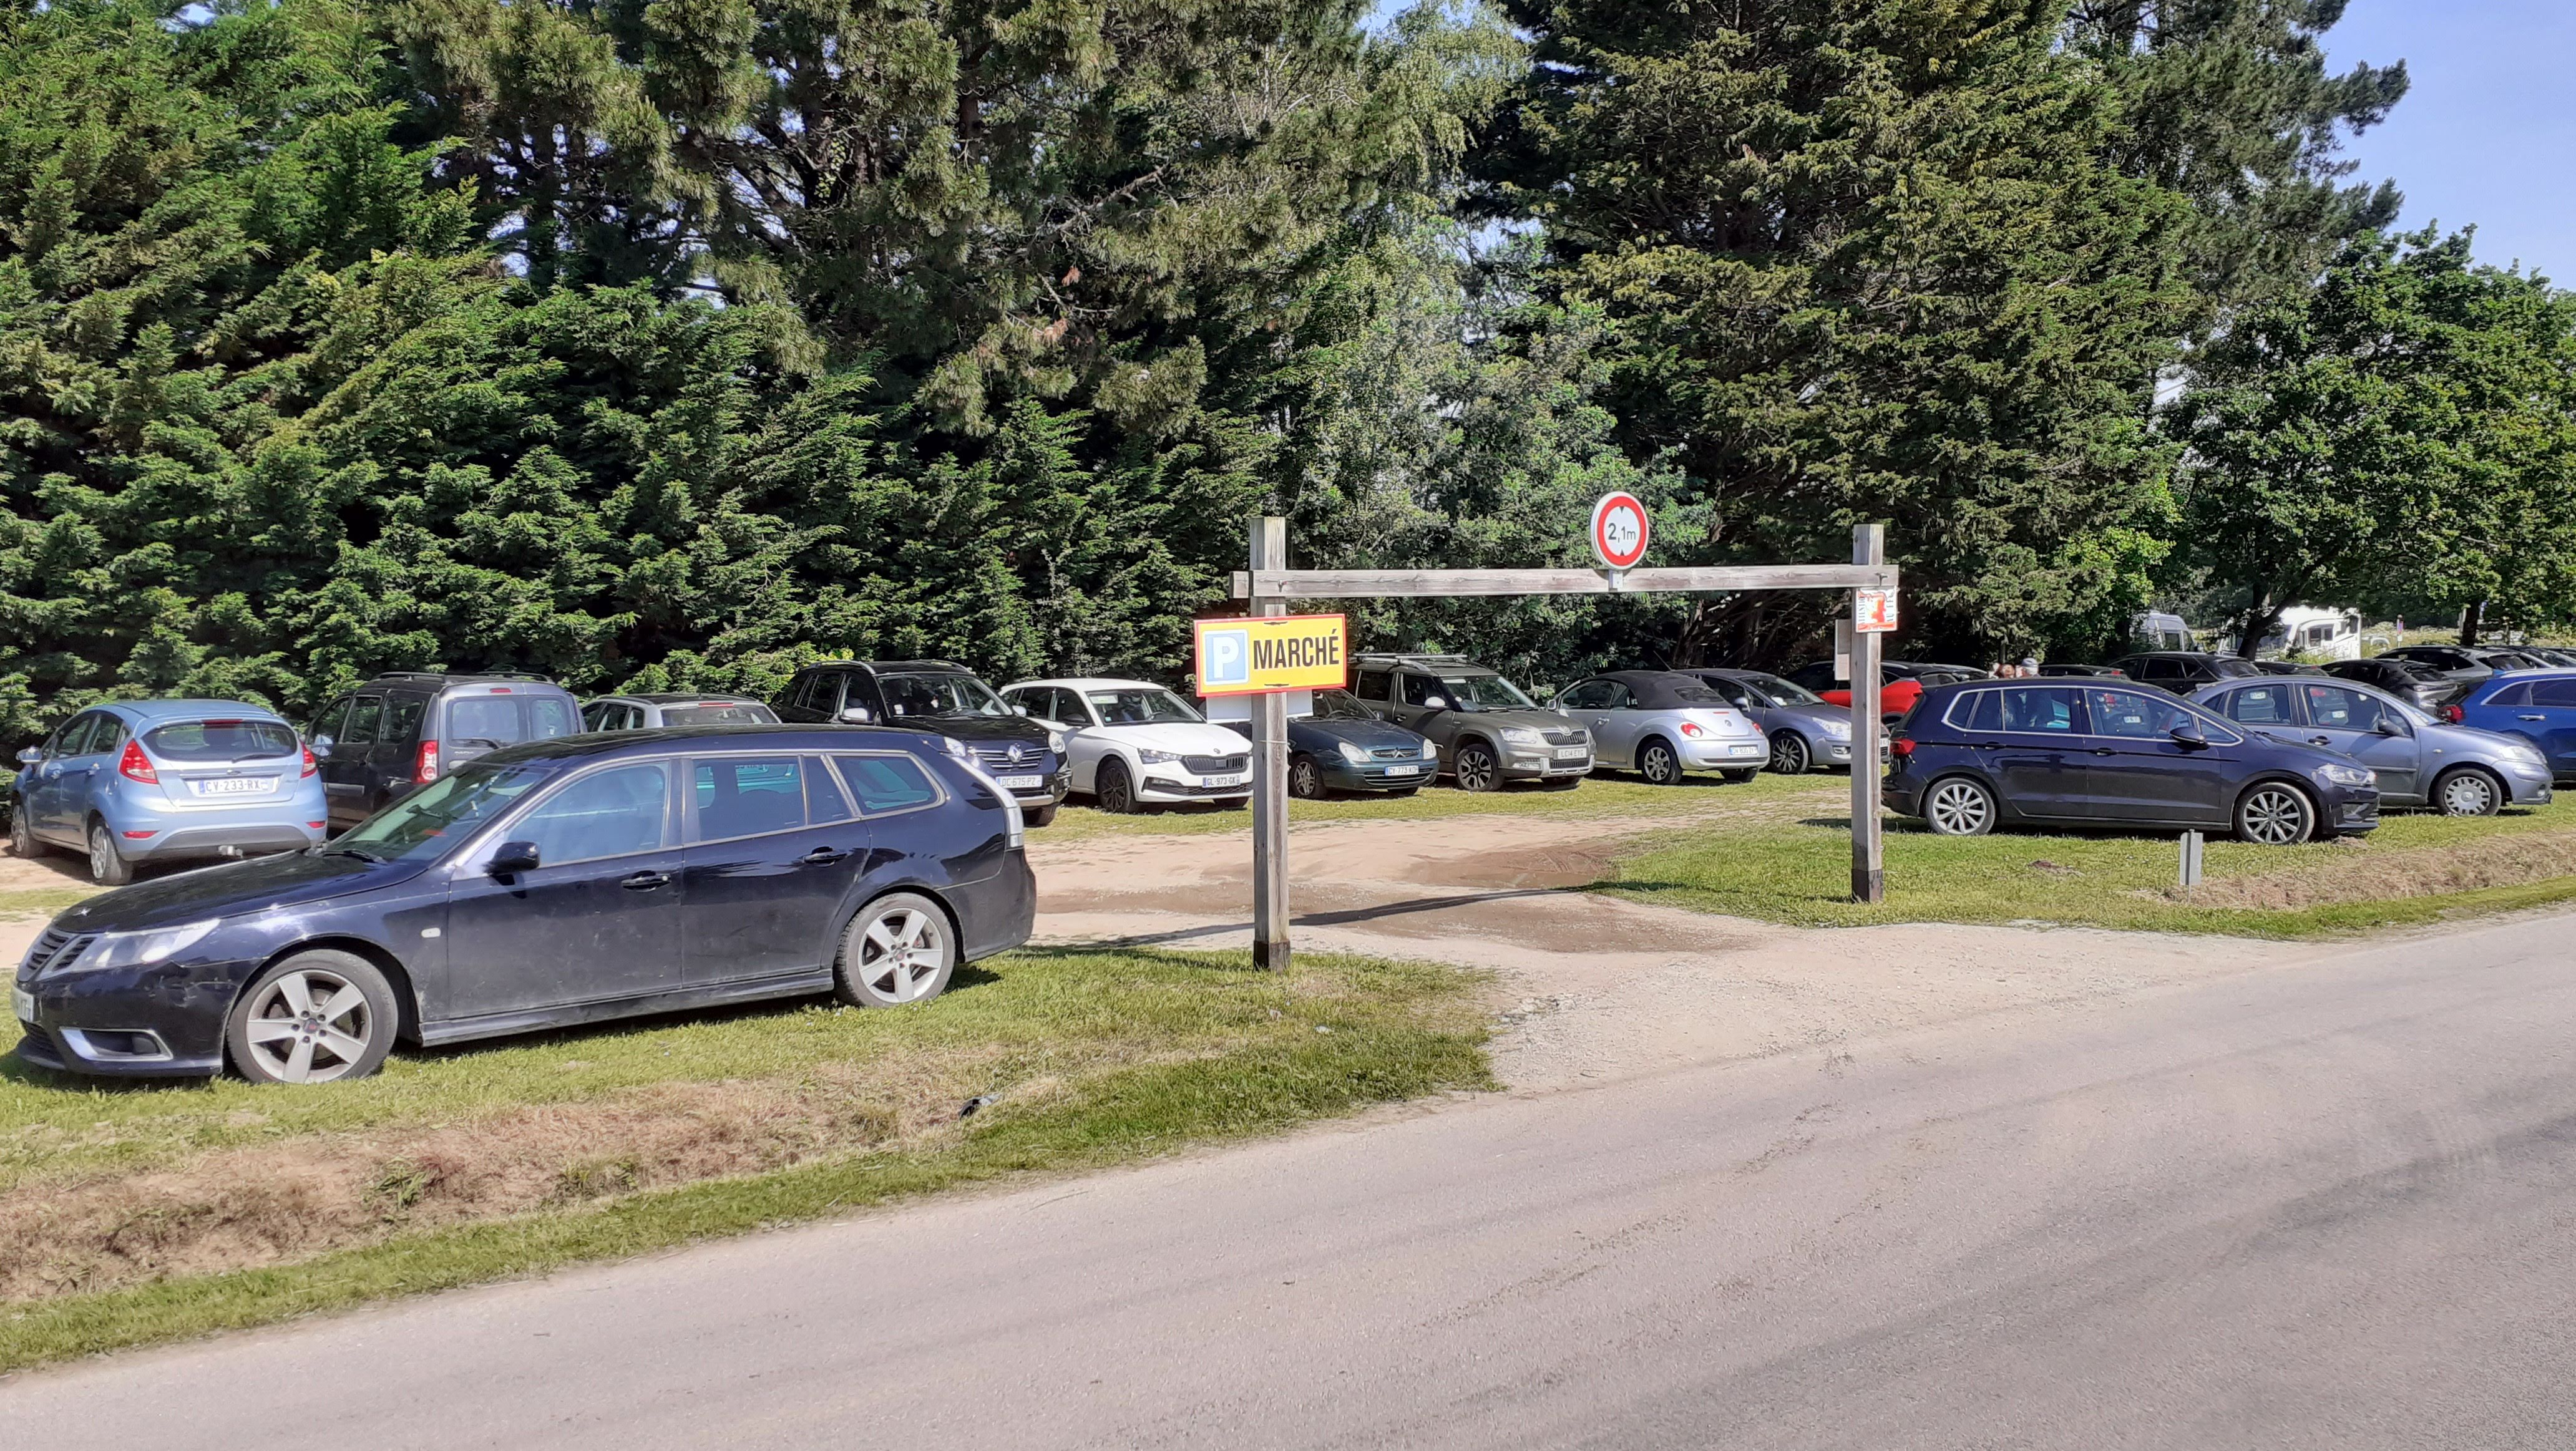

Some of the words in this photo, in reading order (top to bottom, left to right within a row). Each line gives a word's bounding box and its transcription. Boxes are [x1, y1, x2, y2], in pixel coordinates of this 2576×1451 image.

[1608, 523, 1636, 543] 2,1m
[1212, 636, 1239, 679] P
[1253, 628, 1339, 670] MARCHÉ
